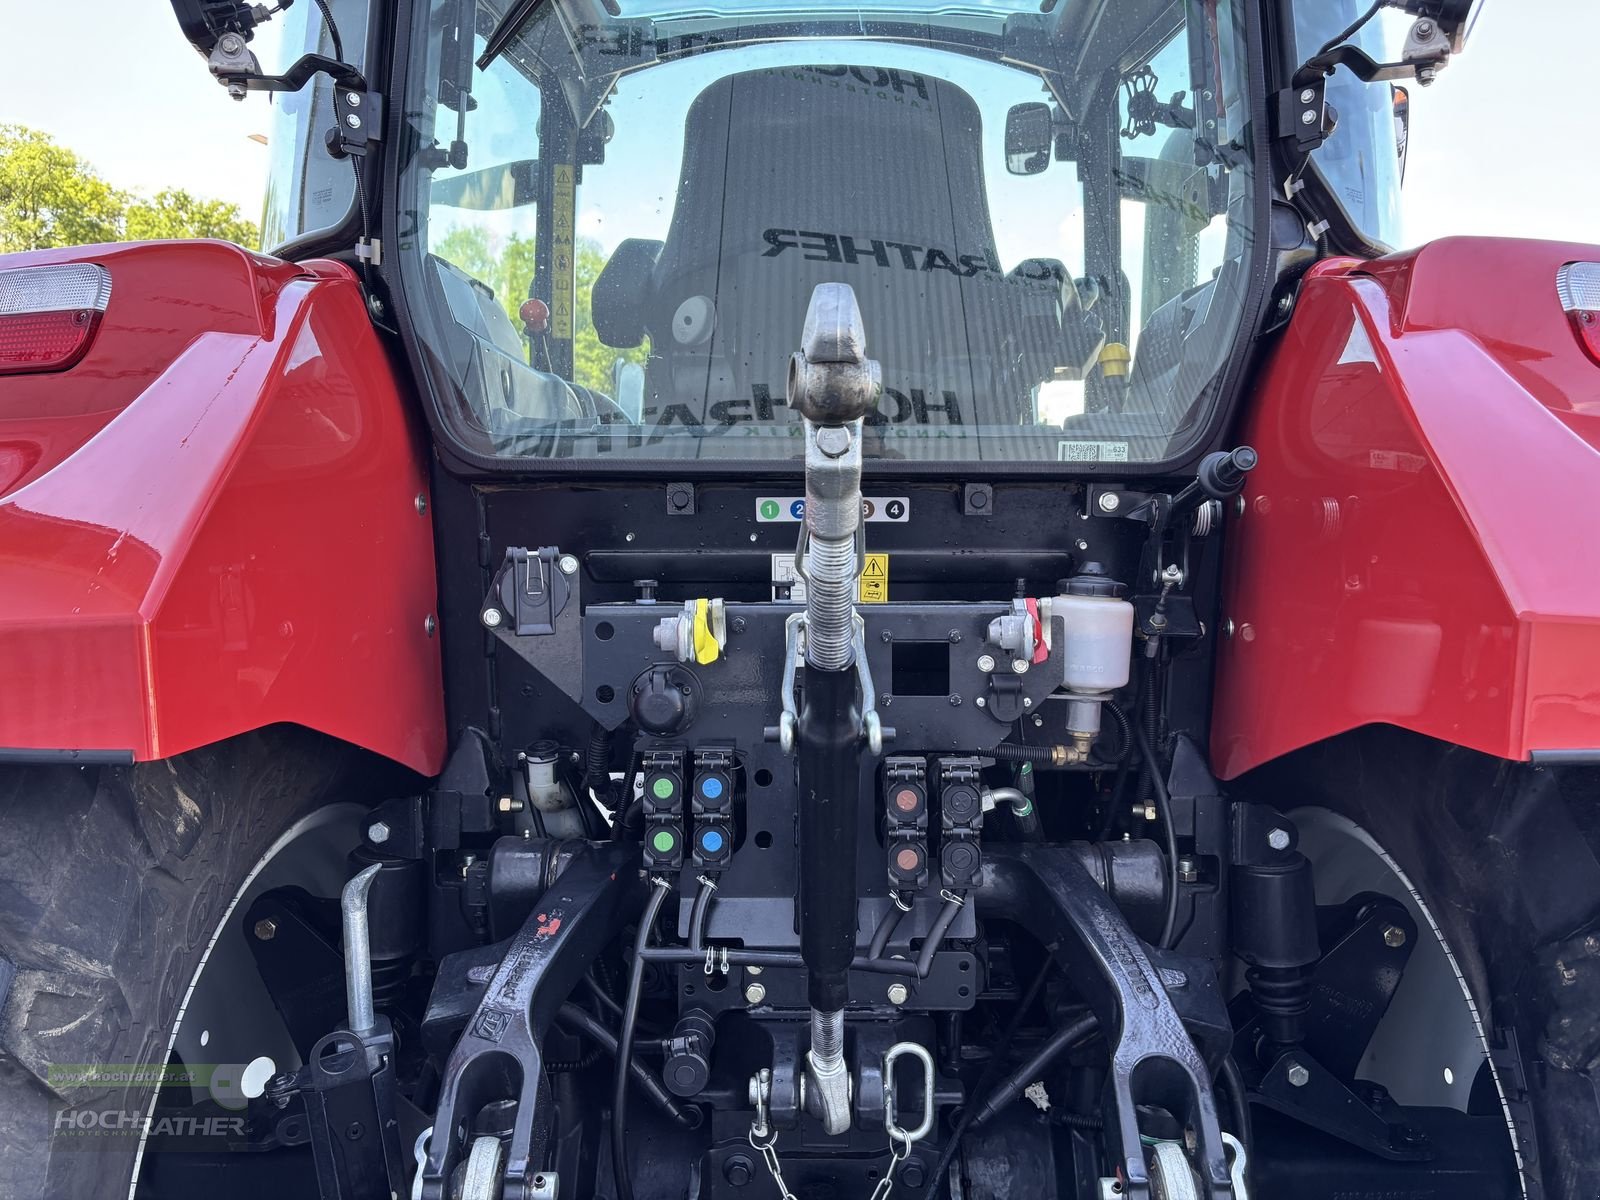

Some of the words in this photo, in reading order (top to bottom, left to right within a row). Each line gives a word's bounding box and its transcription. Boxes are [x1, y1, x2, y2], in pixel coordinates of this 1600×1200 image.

[767, 504, 773, 515] 1
[795, 504, 804, 515] 2
[863, 504, 869, 515] 3
[890, 504, 900, 515] 4
